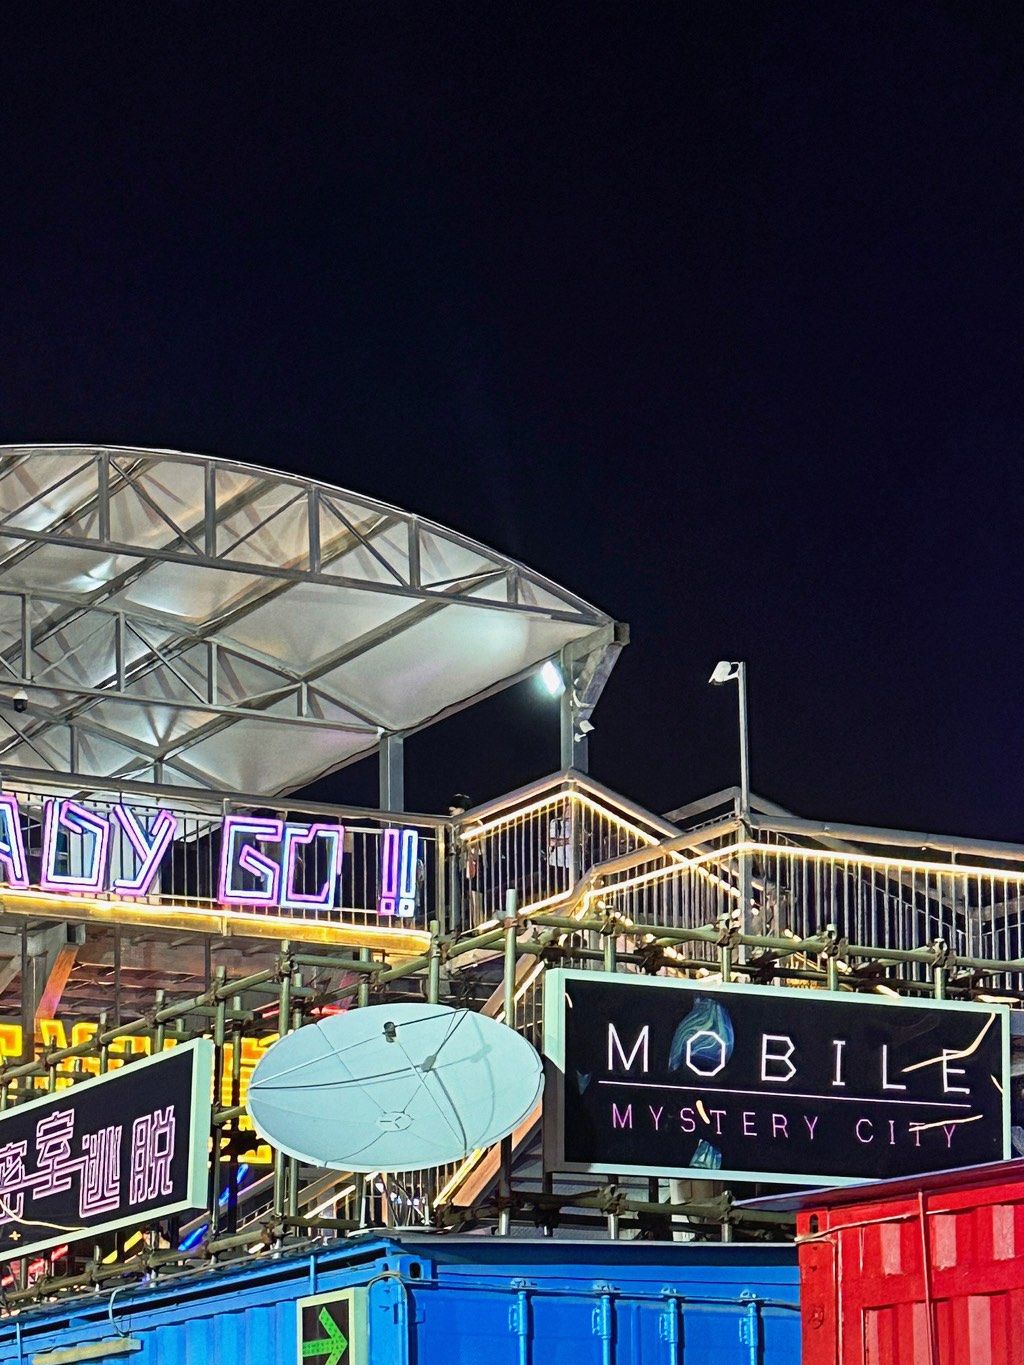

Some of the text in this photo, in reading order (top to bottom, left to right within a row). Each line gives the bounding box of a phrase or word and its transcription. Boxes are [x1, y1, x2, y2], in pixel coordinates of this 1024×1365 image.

[607, 1022, 971, 1095] MOBILE
[611, 1102, 957, 1149] MYSTERY CITY
